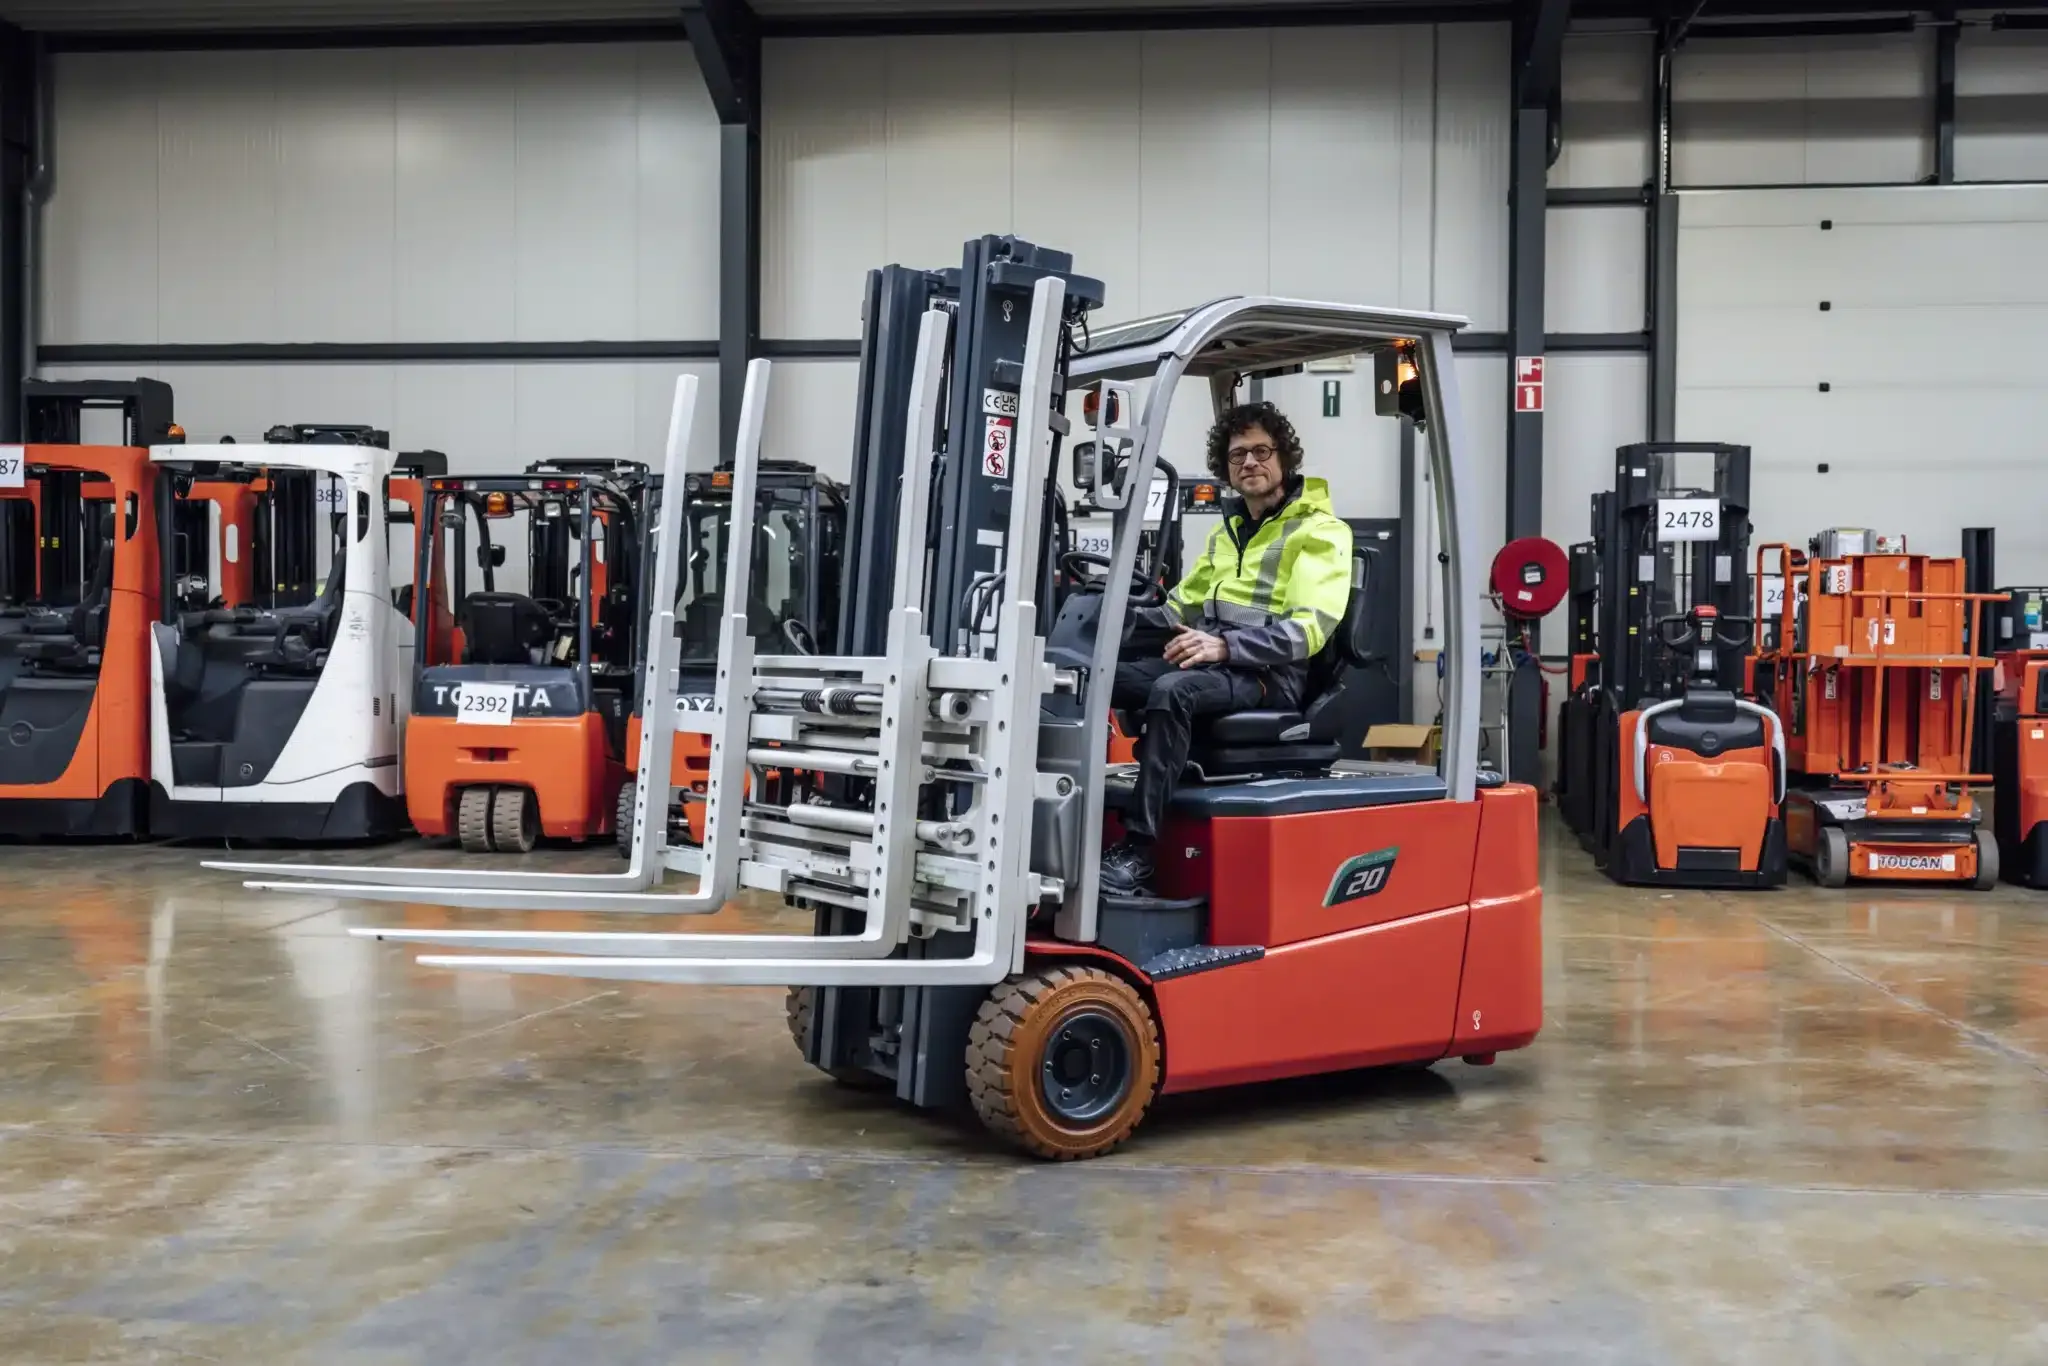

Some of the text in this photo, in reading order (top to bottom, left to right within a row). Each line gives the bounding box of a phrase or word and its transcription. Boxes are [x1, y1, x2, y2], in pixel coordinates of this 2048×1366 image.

[985, 394, 1000, 409] CE
[1002, 394, 1016, 405] UK
[1001, 403, 1016, 414] CA
[1664, 511, 1714, 528] 2478
[464, 695, 507, 713] 2392
[1879, 855, 1942, 870] TOUCAN
[1346, 866, 1386, 896] 20
